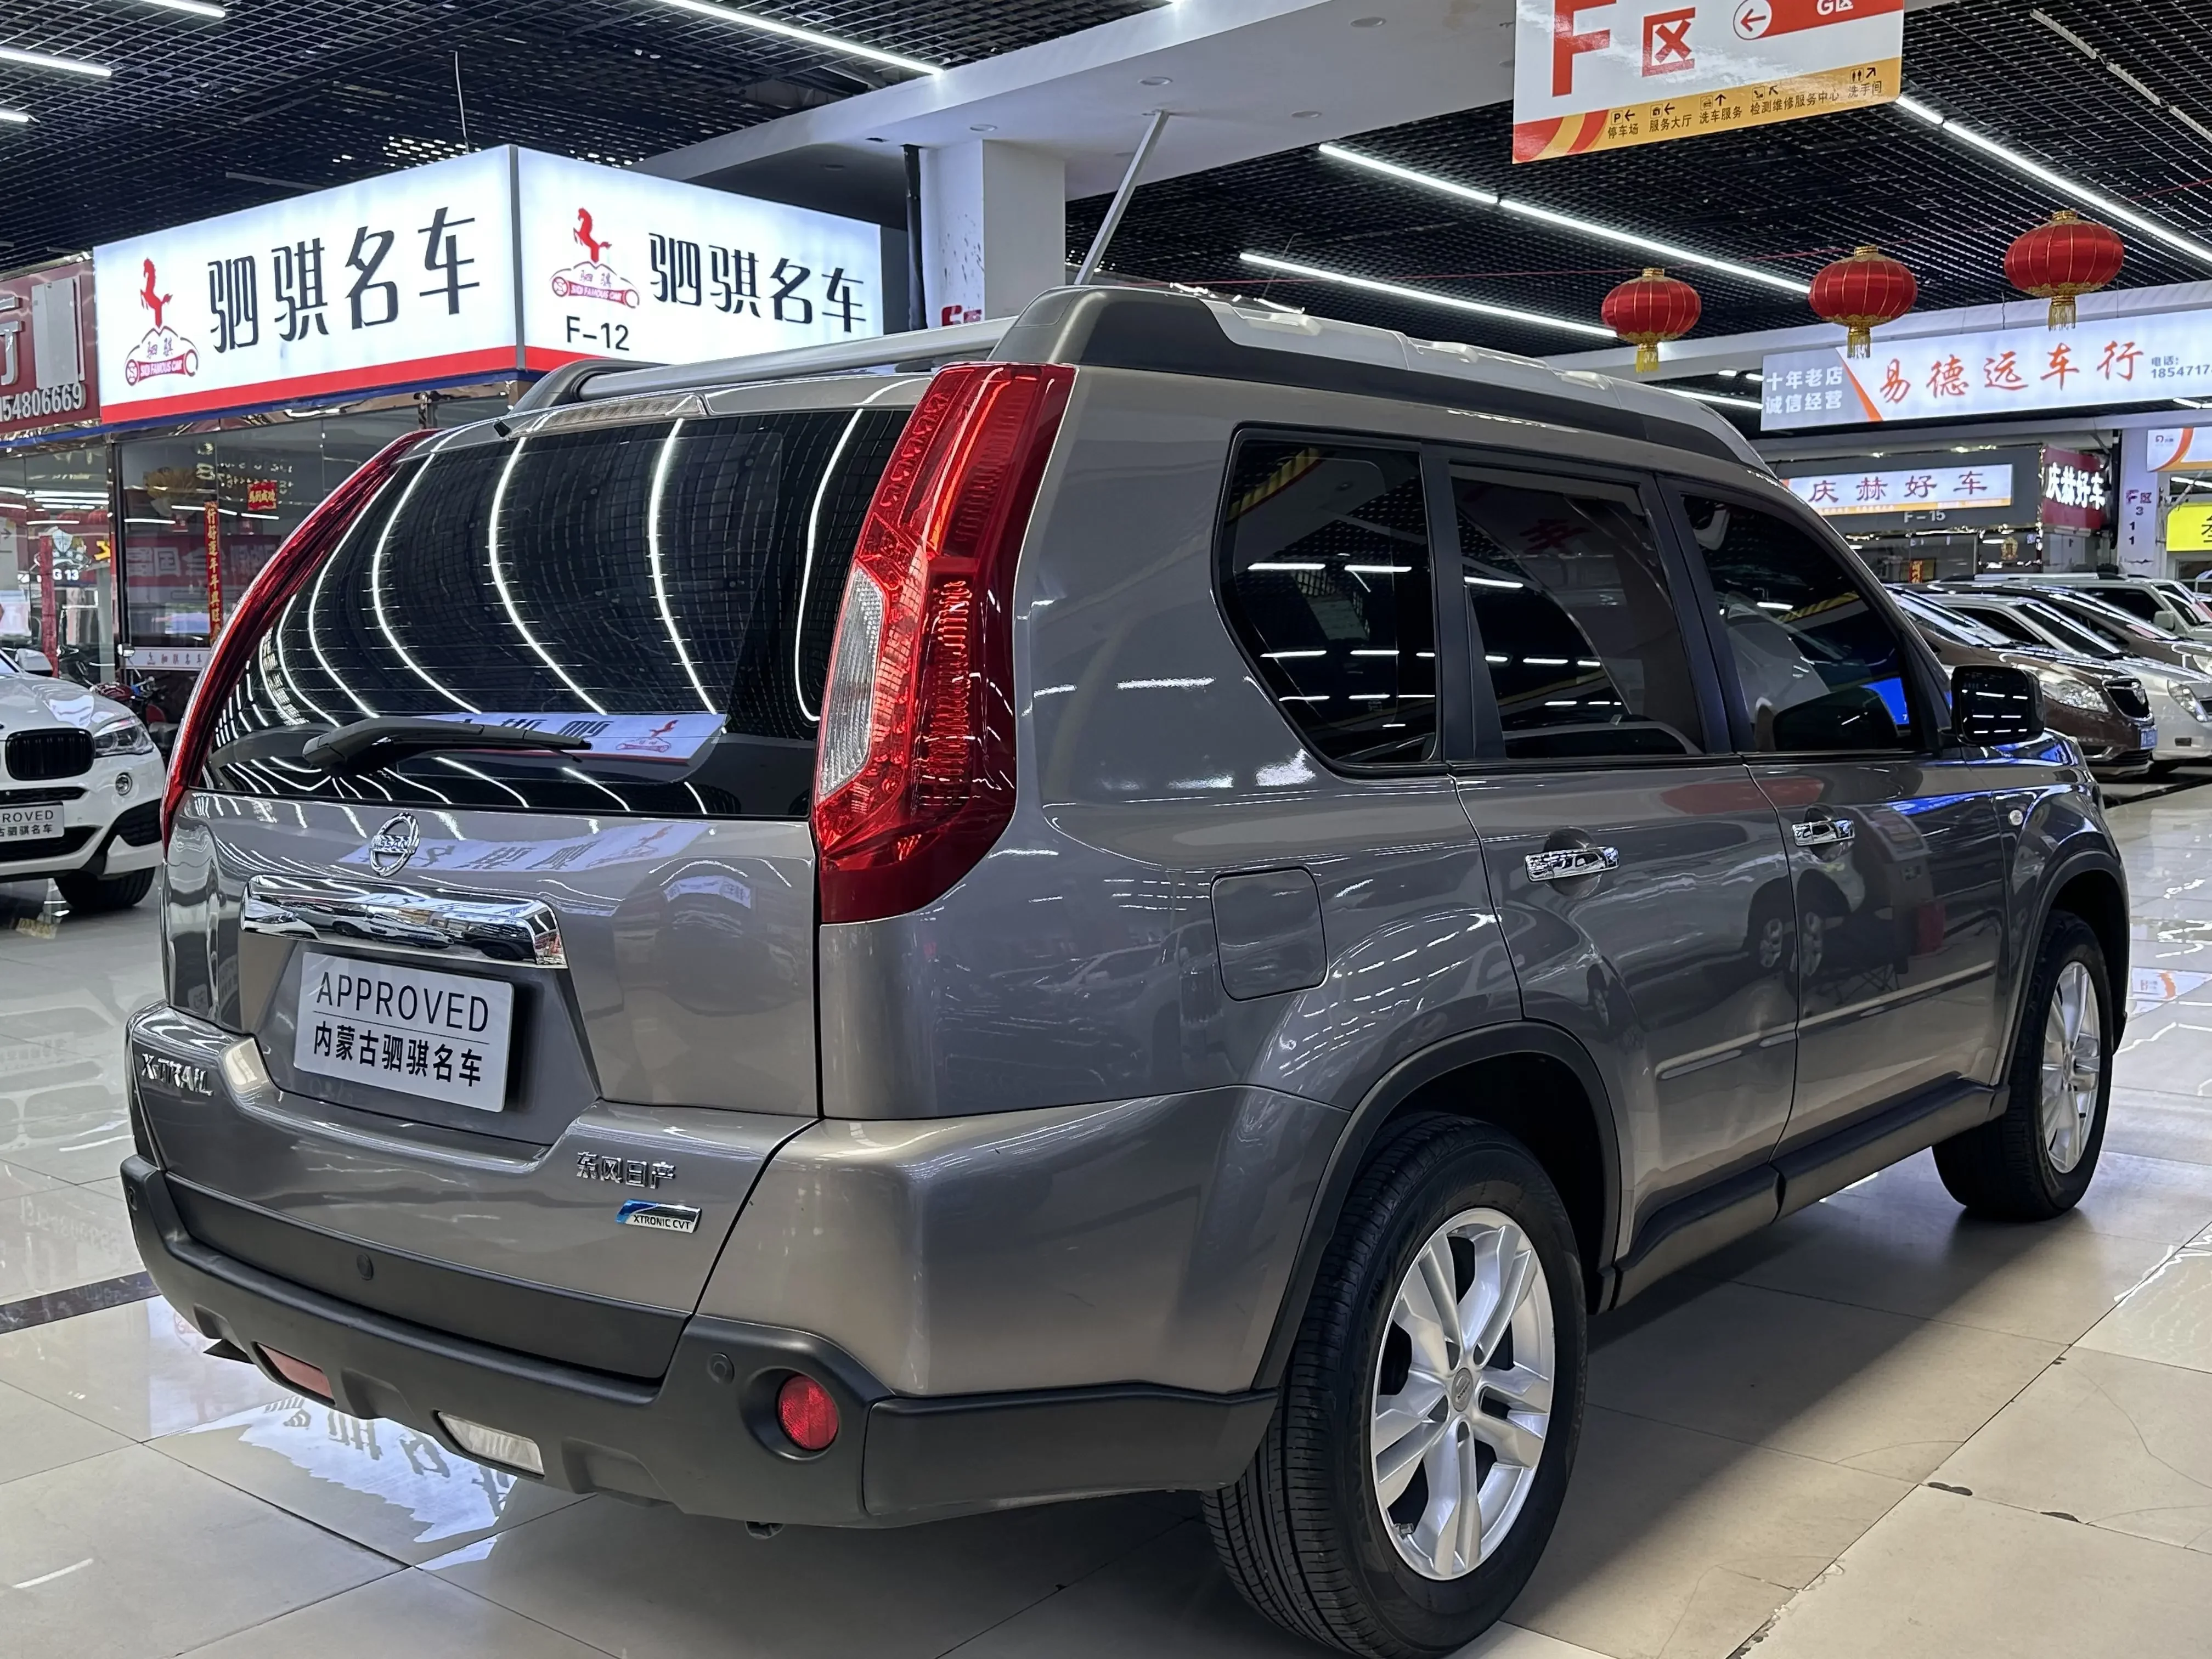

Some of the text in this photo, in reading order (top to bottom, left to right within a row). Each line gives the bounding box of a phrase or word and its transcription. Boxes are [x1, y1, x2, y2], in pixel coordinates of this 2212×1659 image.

[1607, 80, 1882, 139] 停车场 服务大厅 洗车服务 检测维修服务中心 洗手间
[207, 206, 481, 354] 驷骐名车
[648, 232, 867, 333] 驷骐名车
[567, 315, 630, 351] F-12
[1766, 366, 1843, 391] 十年老店
[1880, 340, 2144, 404] 易德远车行
[2151, 364, 2212, 379] 1854717
[1765, 390, 1843, 415] 诚信经营
[1807, 470, 1988, 503] 庆赫好车
[2045, 461, 2106, 511] 庆赫好车
[316, 972, 489, 1032] APPROVED
[141, 1052, 215, 1097] X-TRAIL
[313, 1021, 482, 1087] 内蒙古驷骐名车
[577, 1151, 676, 1189] 东风日产
[633, 1215, 691, 1230] XTRONIC CVT
